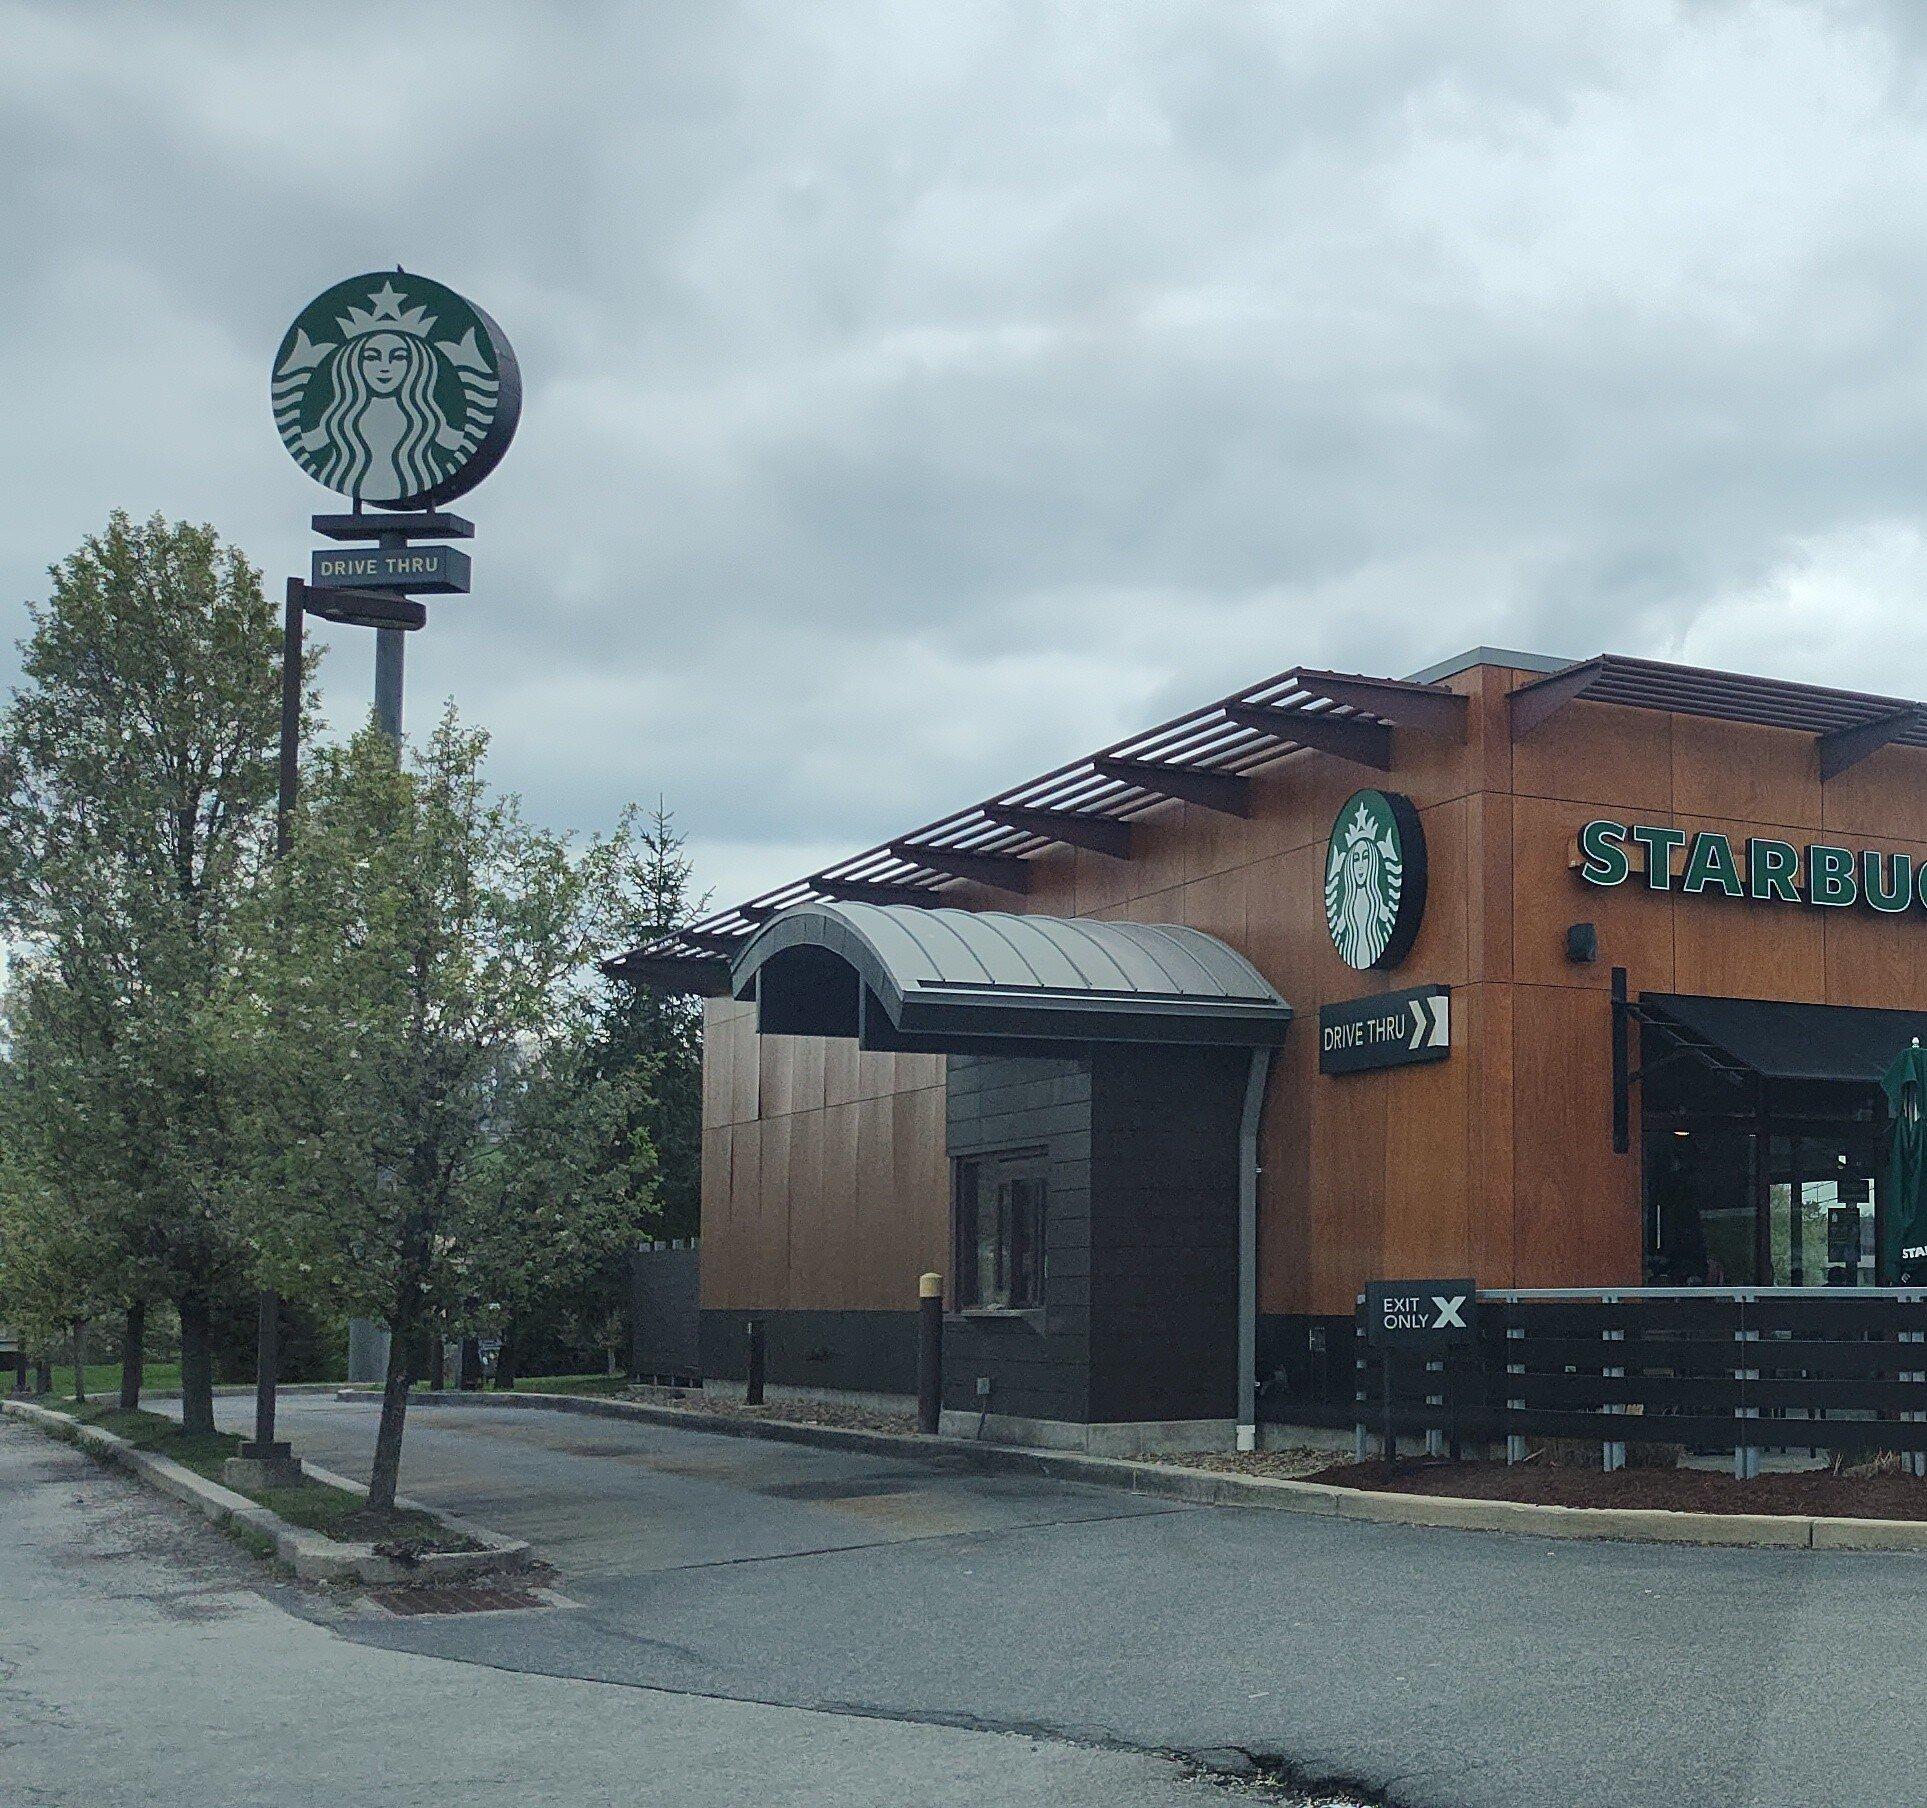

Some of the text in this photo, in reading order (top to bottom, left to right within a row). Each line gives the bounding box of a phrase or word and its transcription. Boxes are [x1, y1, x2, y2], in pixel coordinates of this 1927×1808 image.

[321, 557, 439, 576] DRIVE THRU
[1580, 819, 1927, 913] STARBU
[1324, 1013, 1405, 1051] DRIVE THRU
[1383, 1297, 1420, 1313] EXIT
[1383, 1313, 1429, 1329] ONLY
